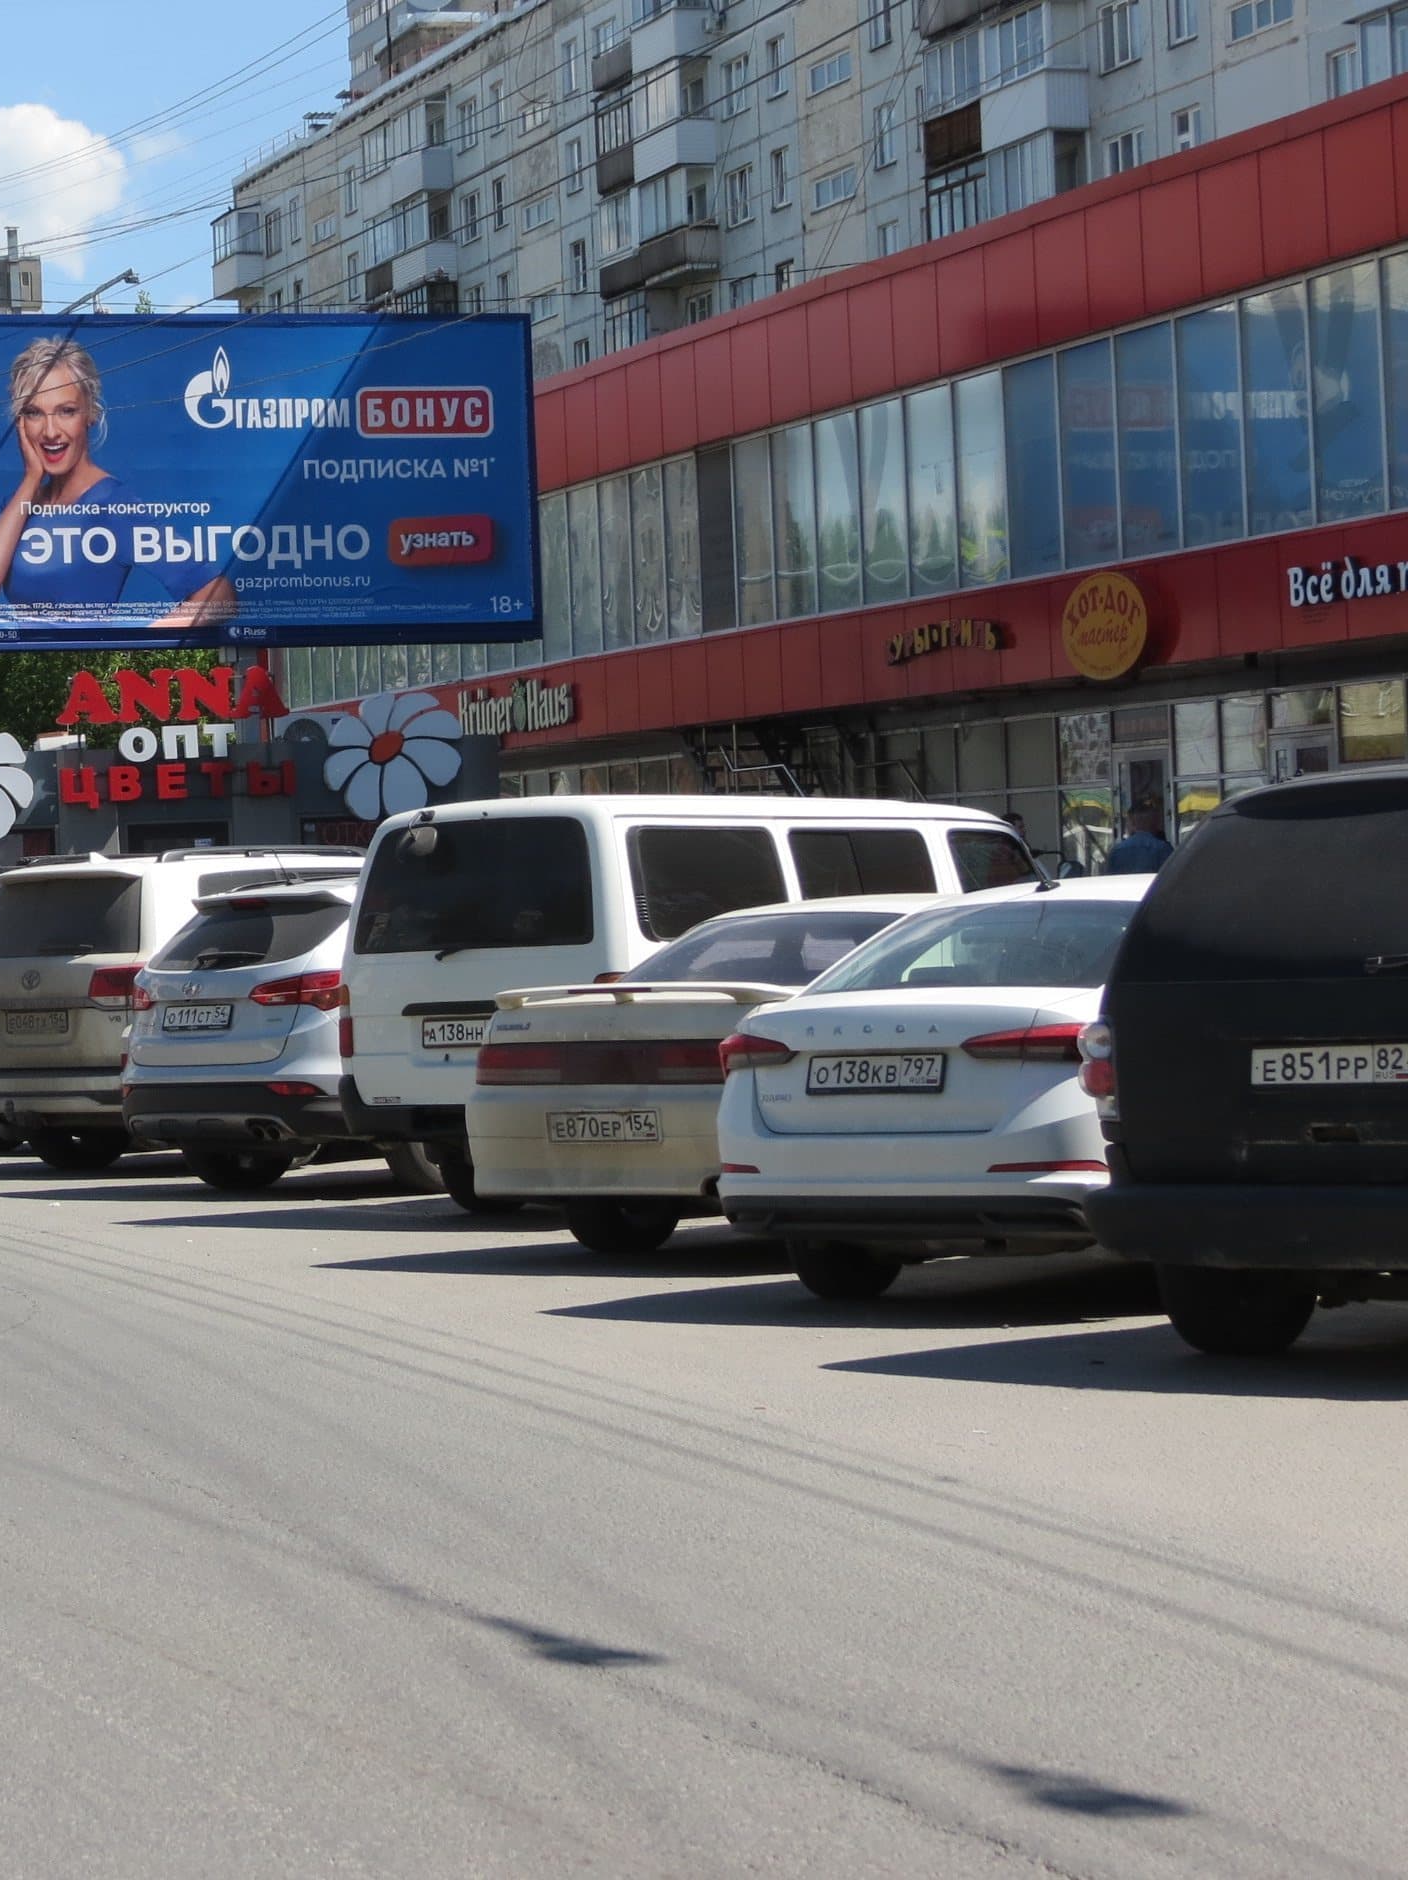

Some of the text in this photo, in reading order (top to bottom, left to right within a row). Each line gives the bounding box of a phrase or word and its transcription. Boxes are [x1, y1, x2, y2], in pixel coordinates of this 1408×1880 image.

[235, 396, 483, 429] ГАЗПРОМ БОНУС
[303, 458, 446, 483] ПОДПИСКА
[19, 501, 211, 518] Подписка-конструктор
[20, 524, 371, 570] ЭТО ВЫГОДНО
[399, 531, 476, 555] узнать
[234, 574, 372, 592] gazprombonus.ru
[1287, 561, 1334, 608] Всё
[1340, 556, 1392, 600] для
[489, 596, 524, 614] 18+
[56, 665, 290, 726] ANNA
[526, 679, 571, 732] Haus
[118, 723, 236, 763] ОПТ
[59, 760, 297, 810] ЦВЕТЫ
[428, 1023, 484, 1042] А138НН
[816, 1058, 936, 1085] О138КВ 797
[1263, 1047, 1404, 1082] Е851РР 82
[555, 1114, 655, 1138] Е870ЕР 154
